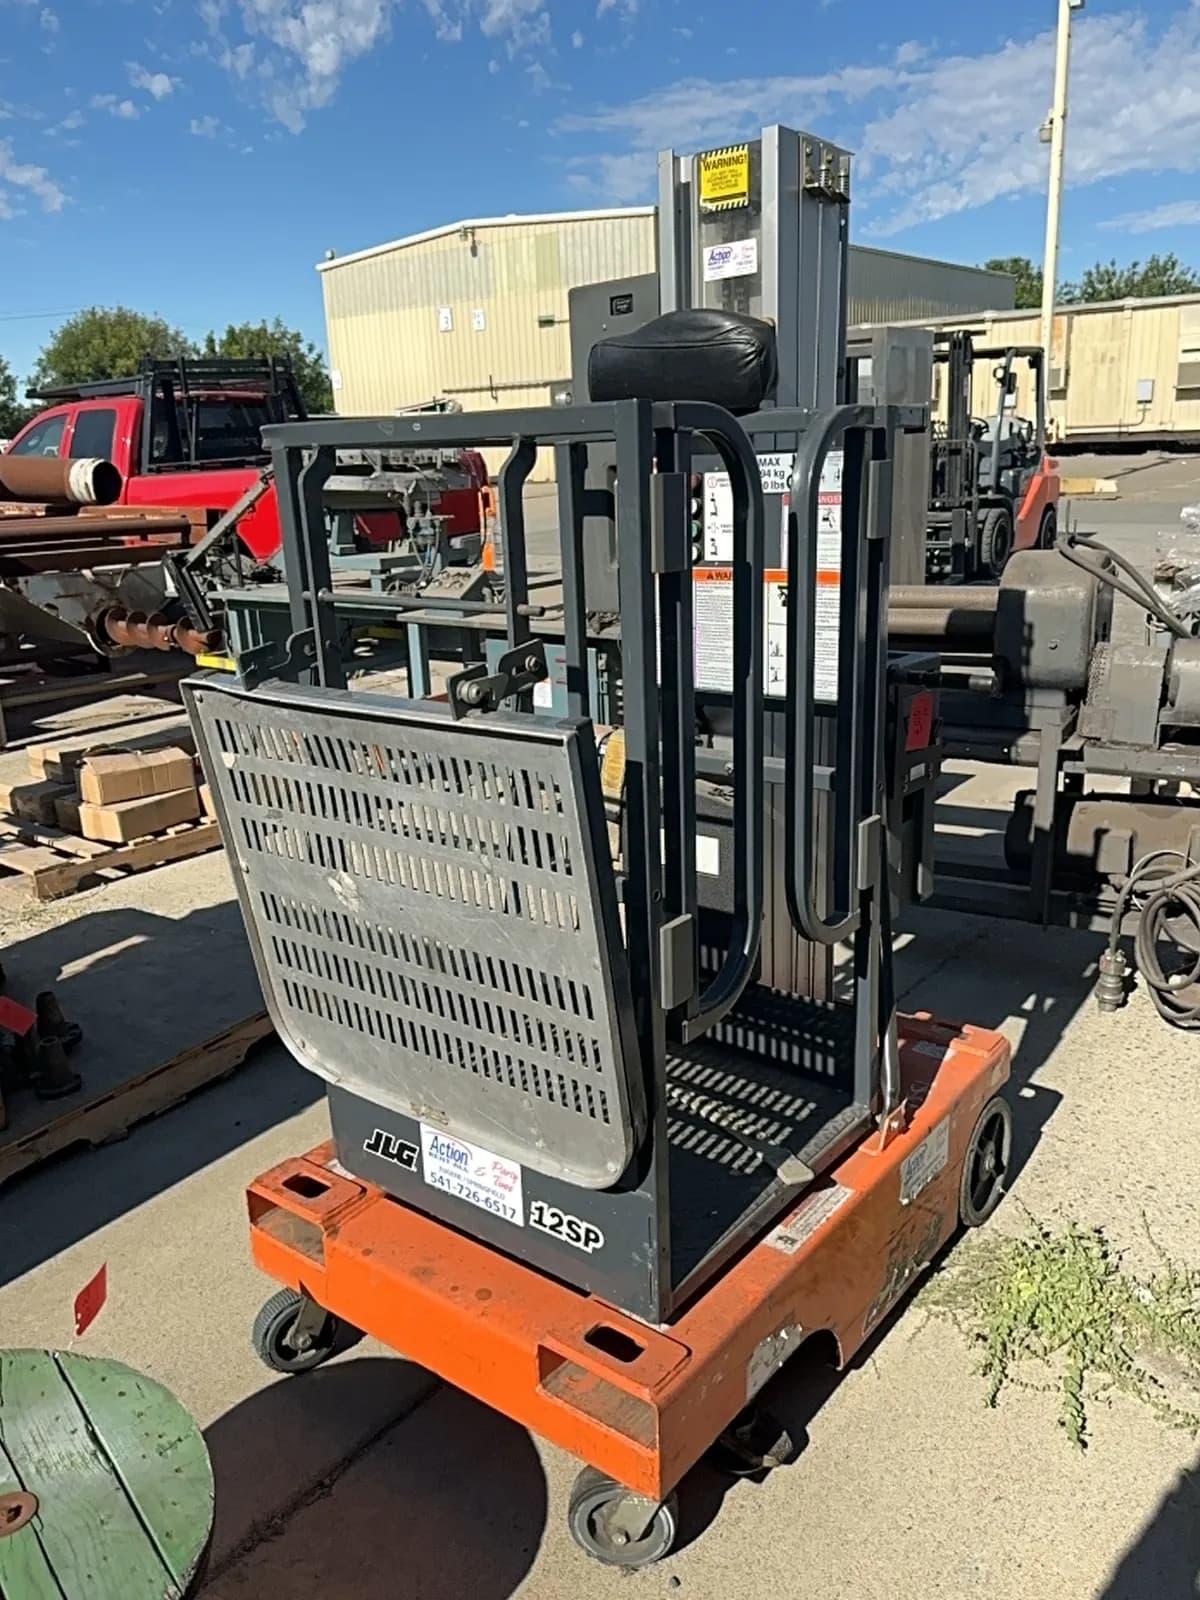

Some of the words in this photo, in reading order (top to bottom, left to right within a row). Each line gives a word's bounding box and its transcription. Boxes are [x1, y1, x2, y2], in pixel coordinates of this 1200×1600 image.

[759, 457, 780, 467] MAX
[773, 469, 785, 480] kg
[770, 480, 785, 490] lbs
[364, 1130, 418, 1170] JLG
[430, 1135, 470, 1166] Action
[430, 1171, 516, 1219] 541-726-6517
[531, 1203, 602, 1250] 12SP
